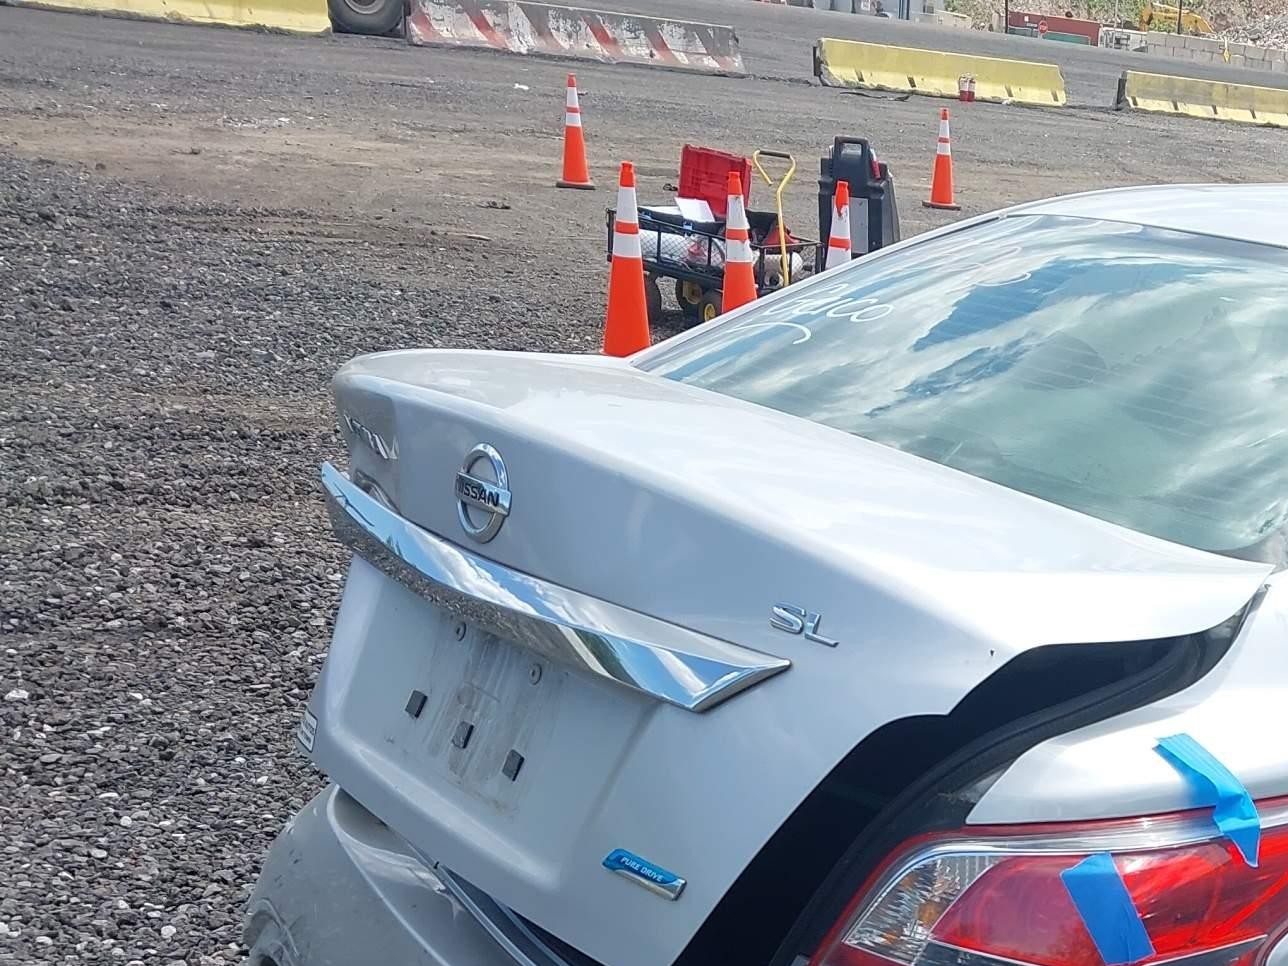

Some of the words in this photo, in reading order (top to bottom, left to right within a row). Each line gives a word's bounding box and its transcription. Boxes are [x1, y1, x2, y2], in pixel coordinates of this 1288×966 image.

[455, 476, 501, 507] NISSAN
[769, 601, 840, 648] SL
[620, 856, 641, 871] PURE
[640, 866, 664, 882] DRIVE
